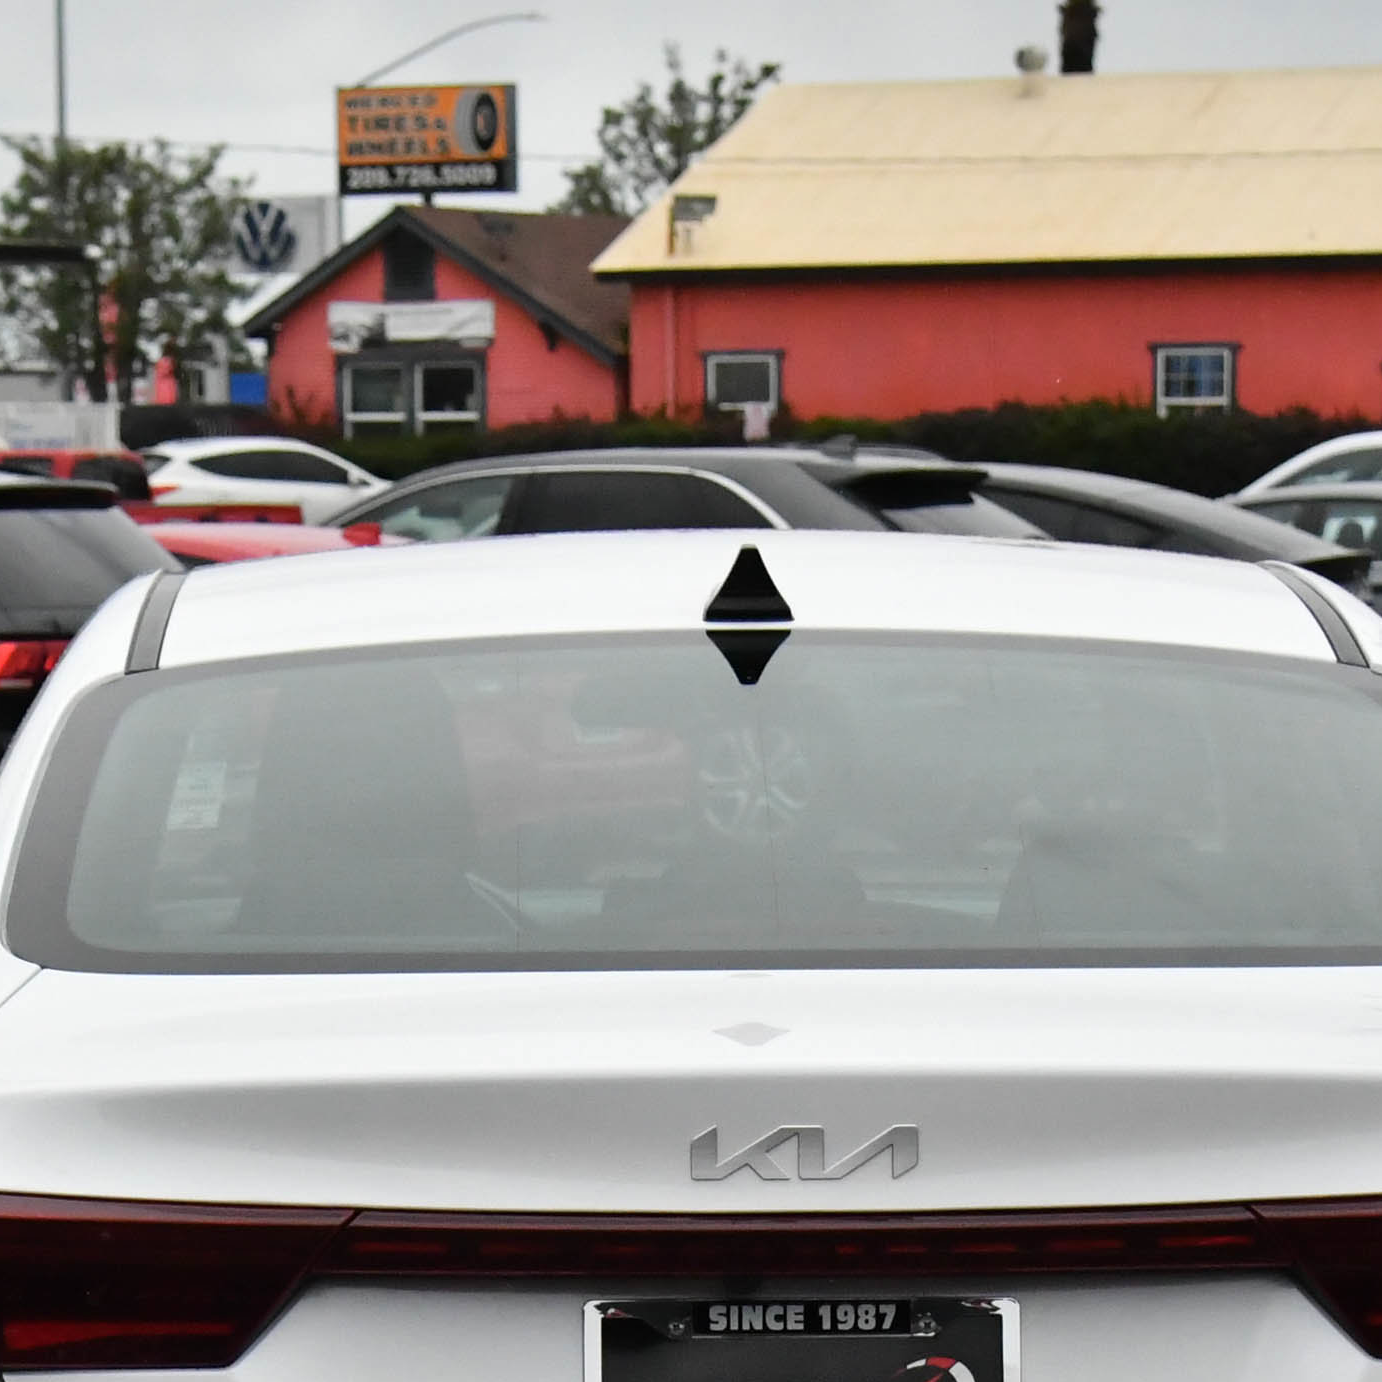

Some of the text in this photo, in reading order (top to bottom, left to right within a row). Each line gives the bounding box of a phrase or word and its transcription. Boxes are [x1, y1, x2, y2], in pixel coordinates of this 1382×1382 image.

[347, 137, 451, 155] WHEELS
[689, 1124, 919, 1181] KIA
[708, 1303, 898, 1332] SINCE 1987
